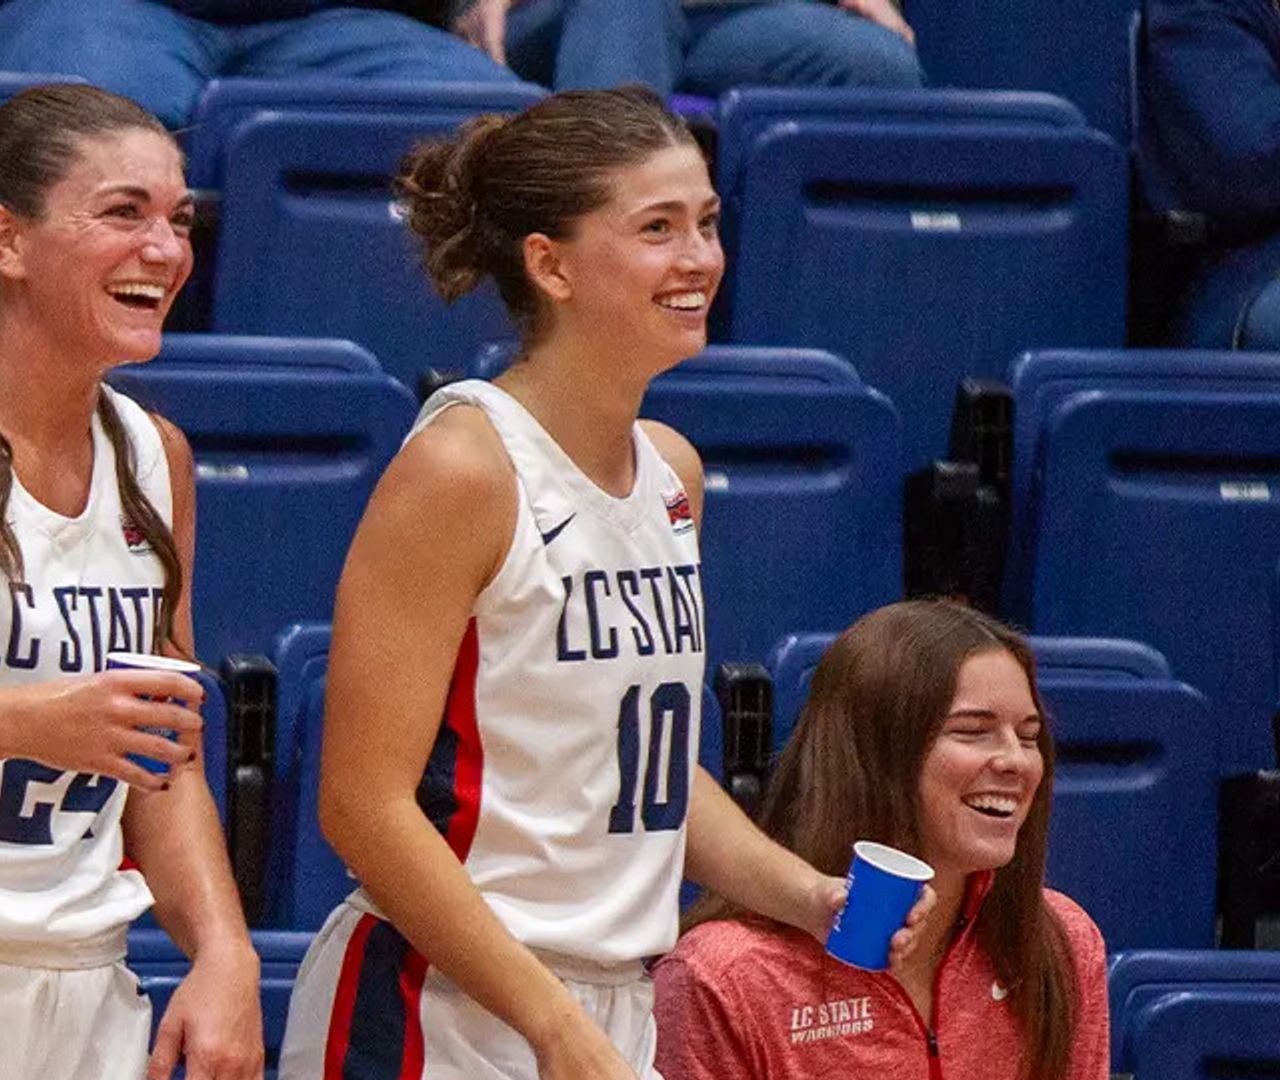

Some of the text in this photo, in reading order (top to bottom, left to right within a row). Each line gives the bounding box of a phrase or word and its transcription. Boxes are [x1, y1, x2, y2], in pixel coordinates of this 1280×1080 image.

[556, 563, 702, 662] LC STAT
[607, 681, 692, 834] 10
[791, 996, 872, 1031] LC STATE
[791, 1018, 874, 1044] WARRIORS
